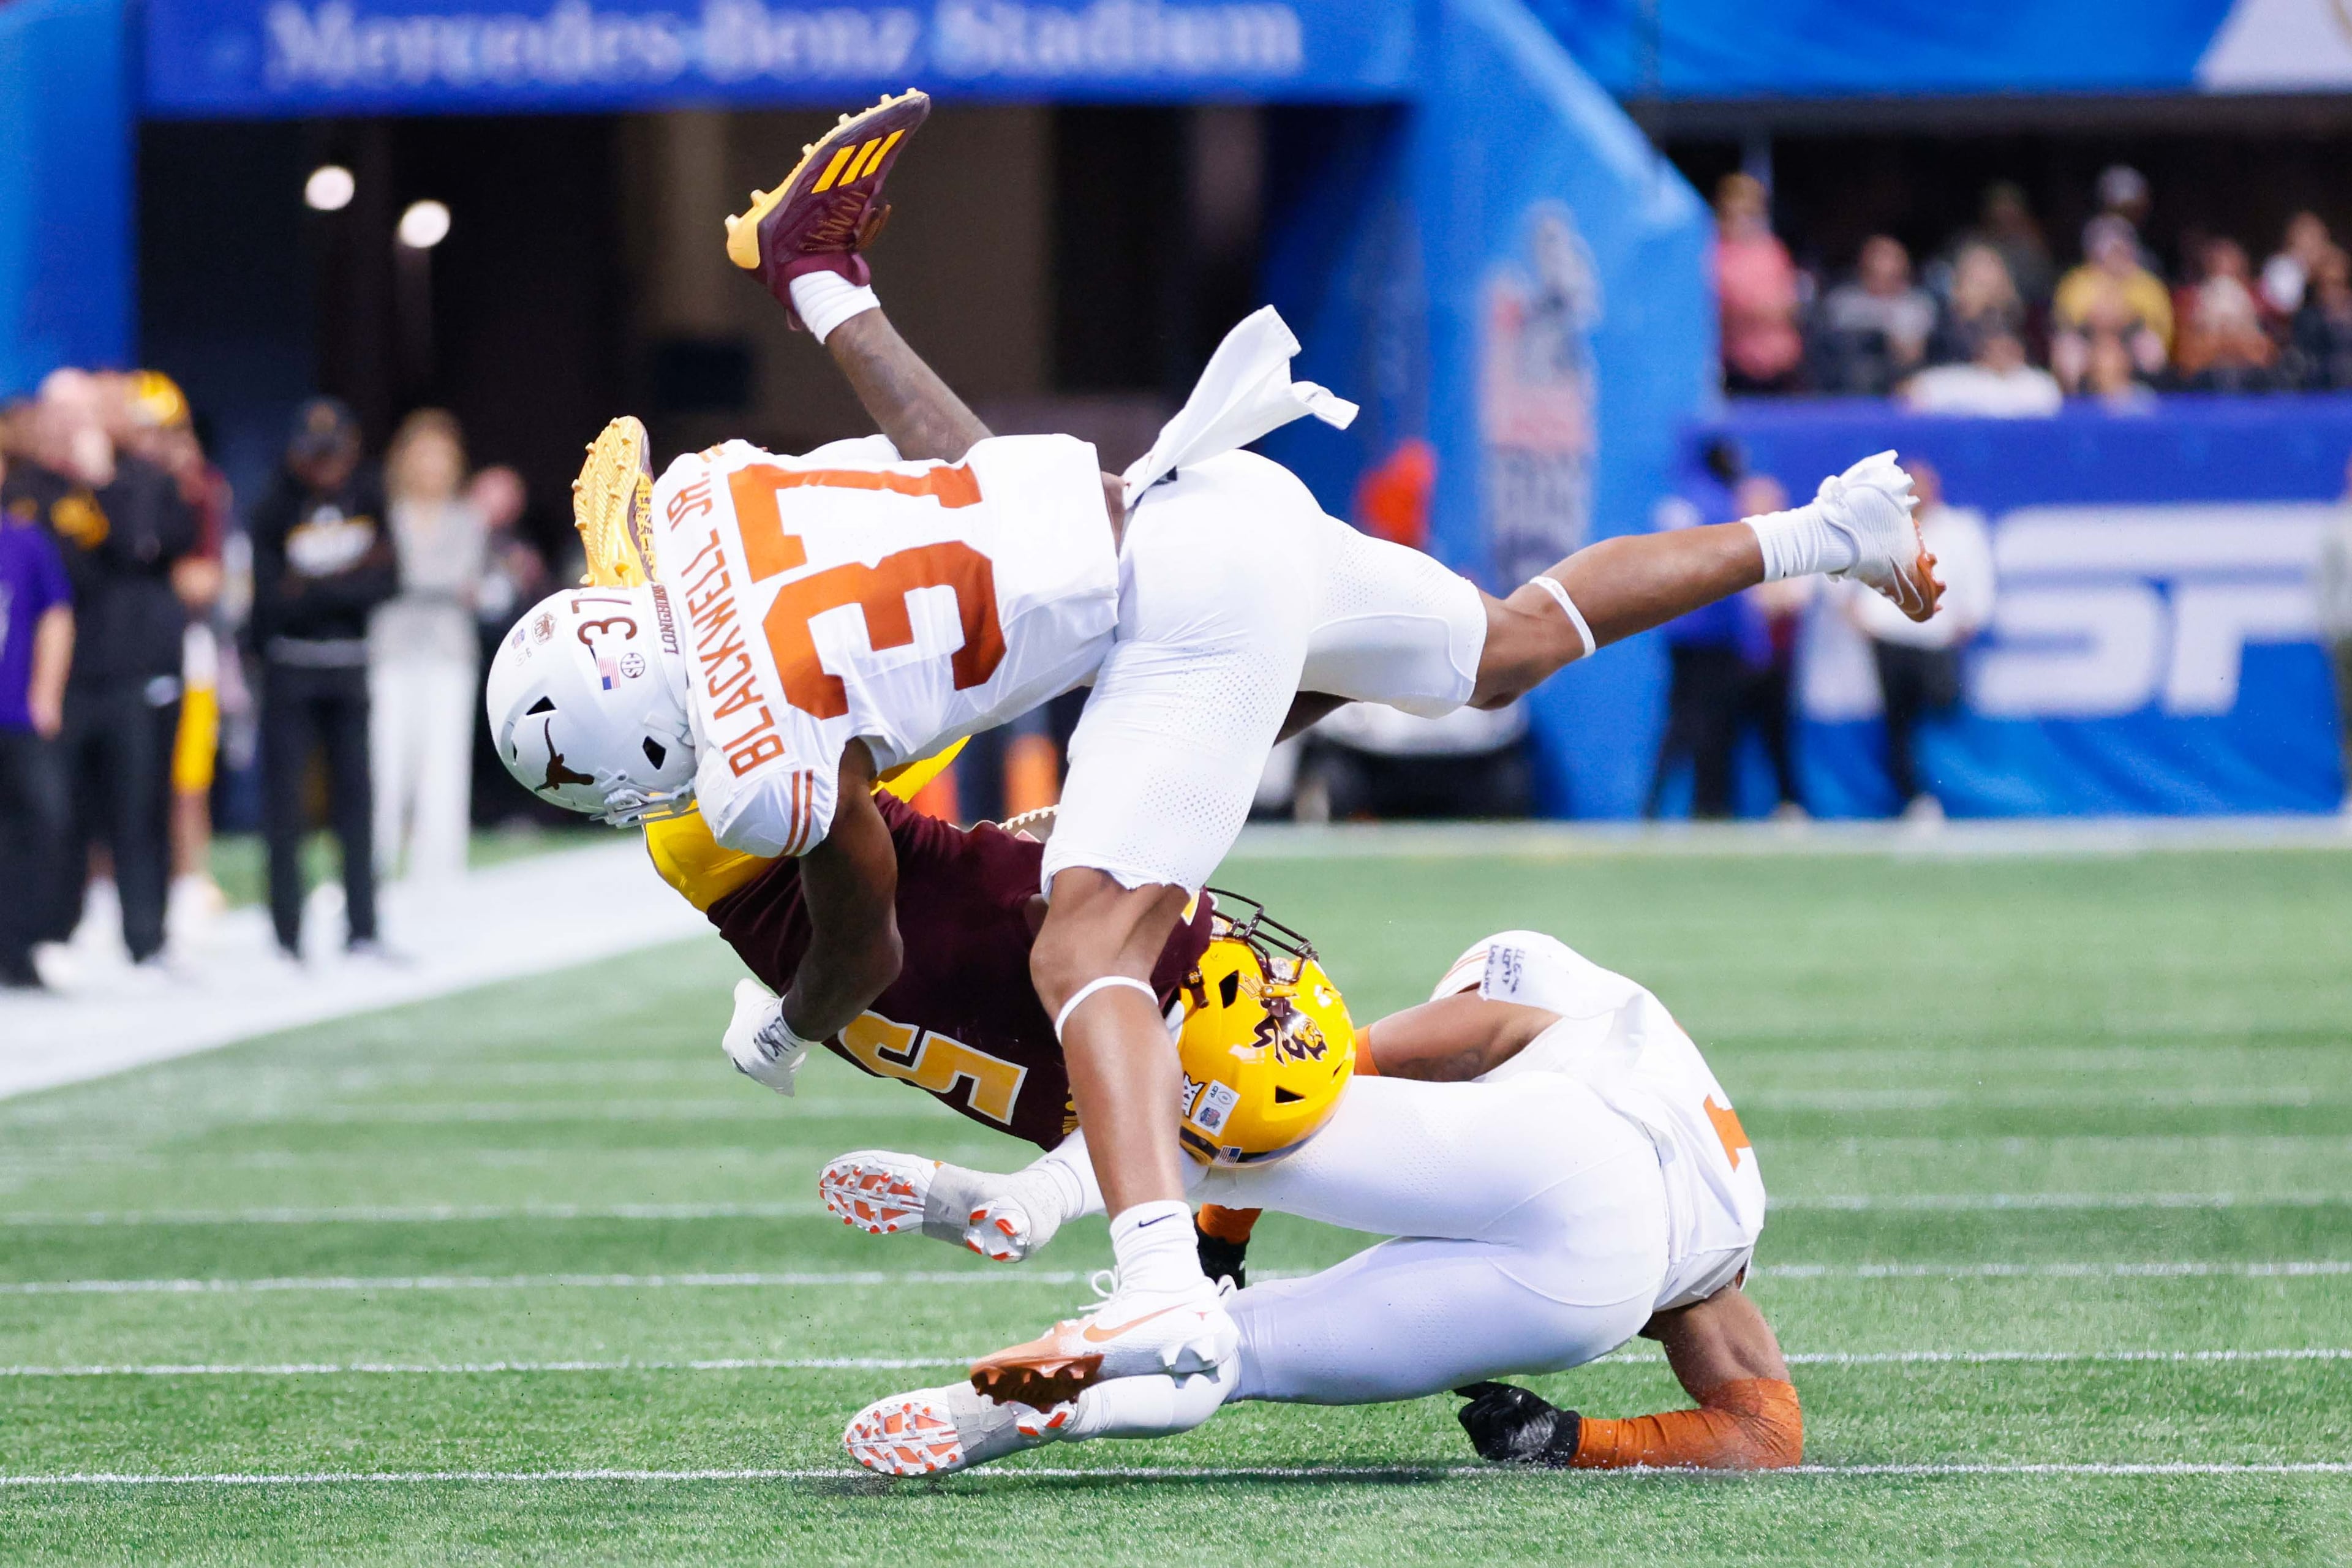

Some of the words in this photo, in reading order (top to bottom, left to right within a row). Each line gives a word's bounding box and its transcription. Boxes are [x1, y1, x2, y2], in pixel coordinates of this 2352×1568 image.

[934, 0, 1303, 78] Stadium
[571, 598, 638, 645] 37
[727, 464, 1006, 720] 37
[682, 528, 785, 777] BLACKWELL
[837, 1009, 1028, 1126] 5
[1210, 1085, 1219, 1098] CFP
